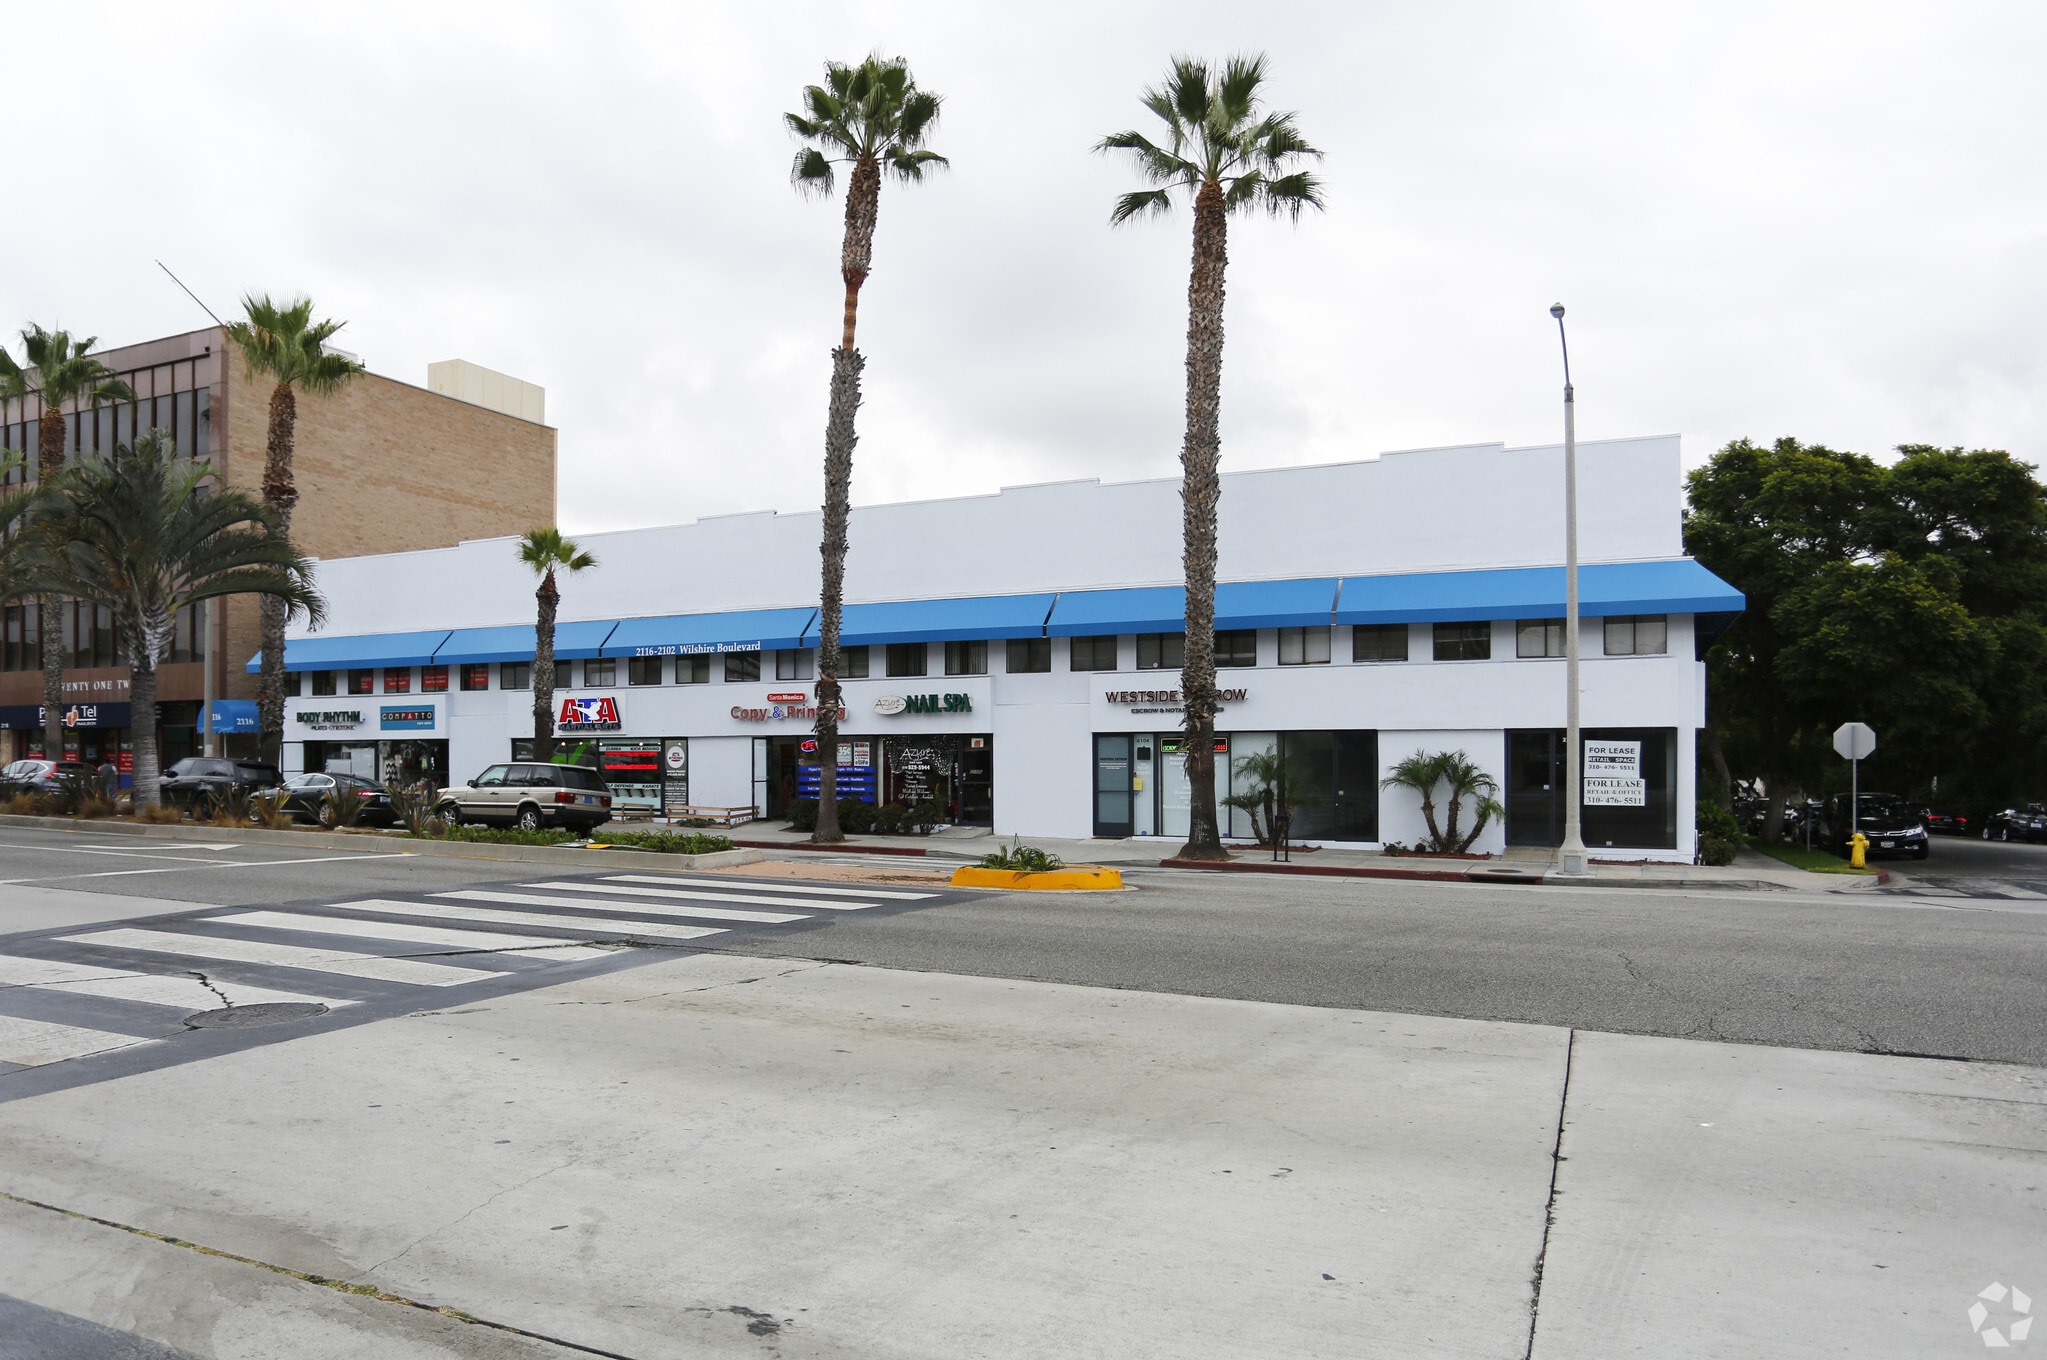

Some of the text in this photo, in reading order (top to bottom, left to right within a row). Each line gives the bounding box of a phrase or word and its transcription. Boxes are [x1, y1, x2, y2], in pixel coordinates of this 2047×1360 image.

[636, 641, 761, 656] 2116-2102 Wilshire Boulevard
[94, 681, 113, 690] ONE
[1105, 690, 1178, 703] WESTSIDE
[906, 693, 972, 713] NAIL SPA
[81, 705, 97, 717] Tel
[559, 697, 618, 723] ATA
[731, 706, 767, 721] Copy
[772, 705, 781, 719] &
[296, 711, 361, 722] BODY RHYTHM
[382, 712, 432, 721] COMPATTO
[1587, 780, 1642, 788] FOR LEASE
[1624, 797, 1642, 805] 5511
